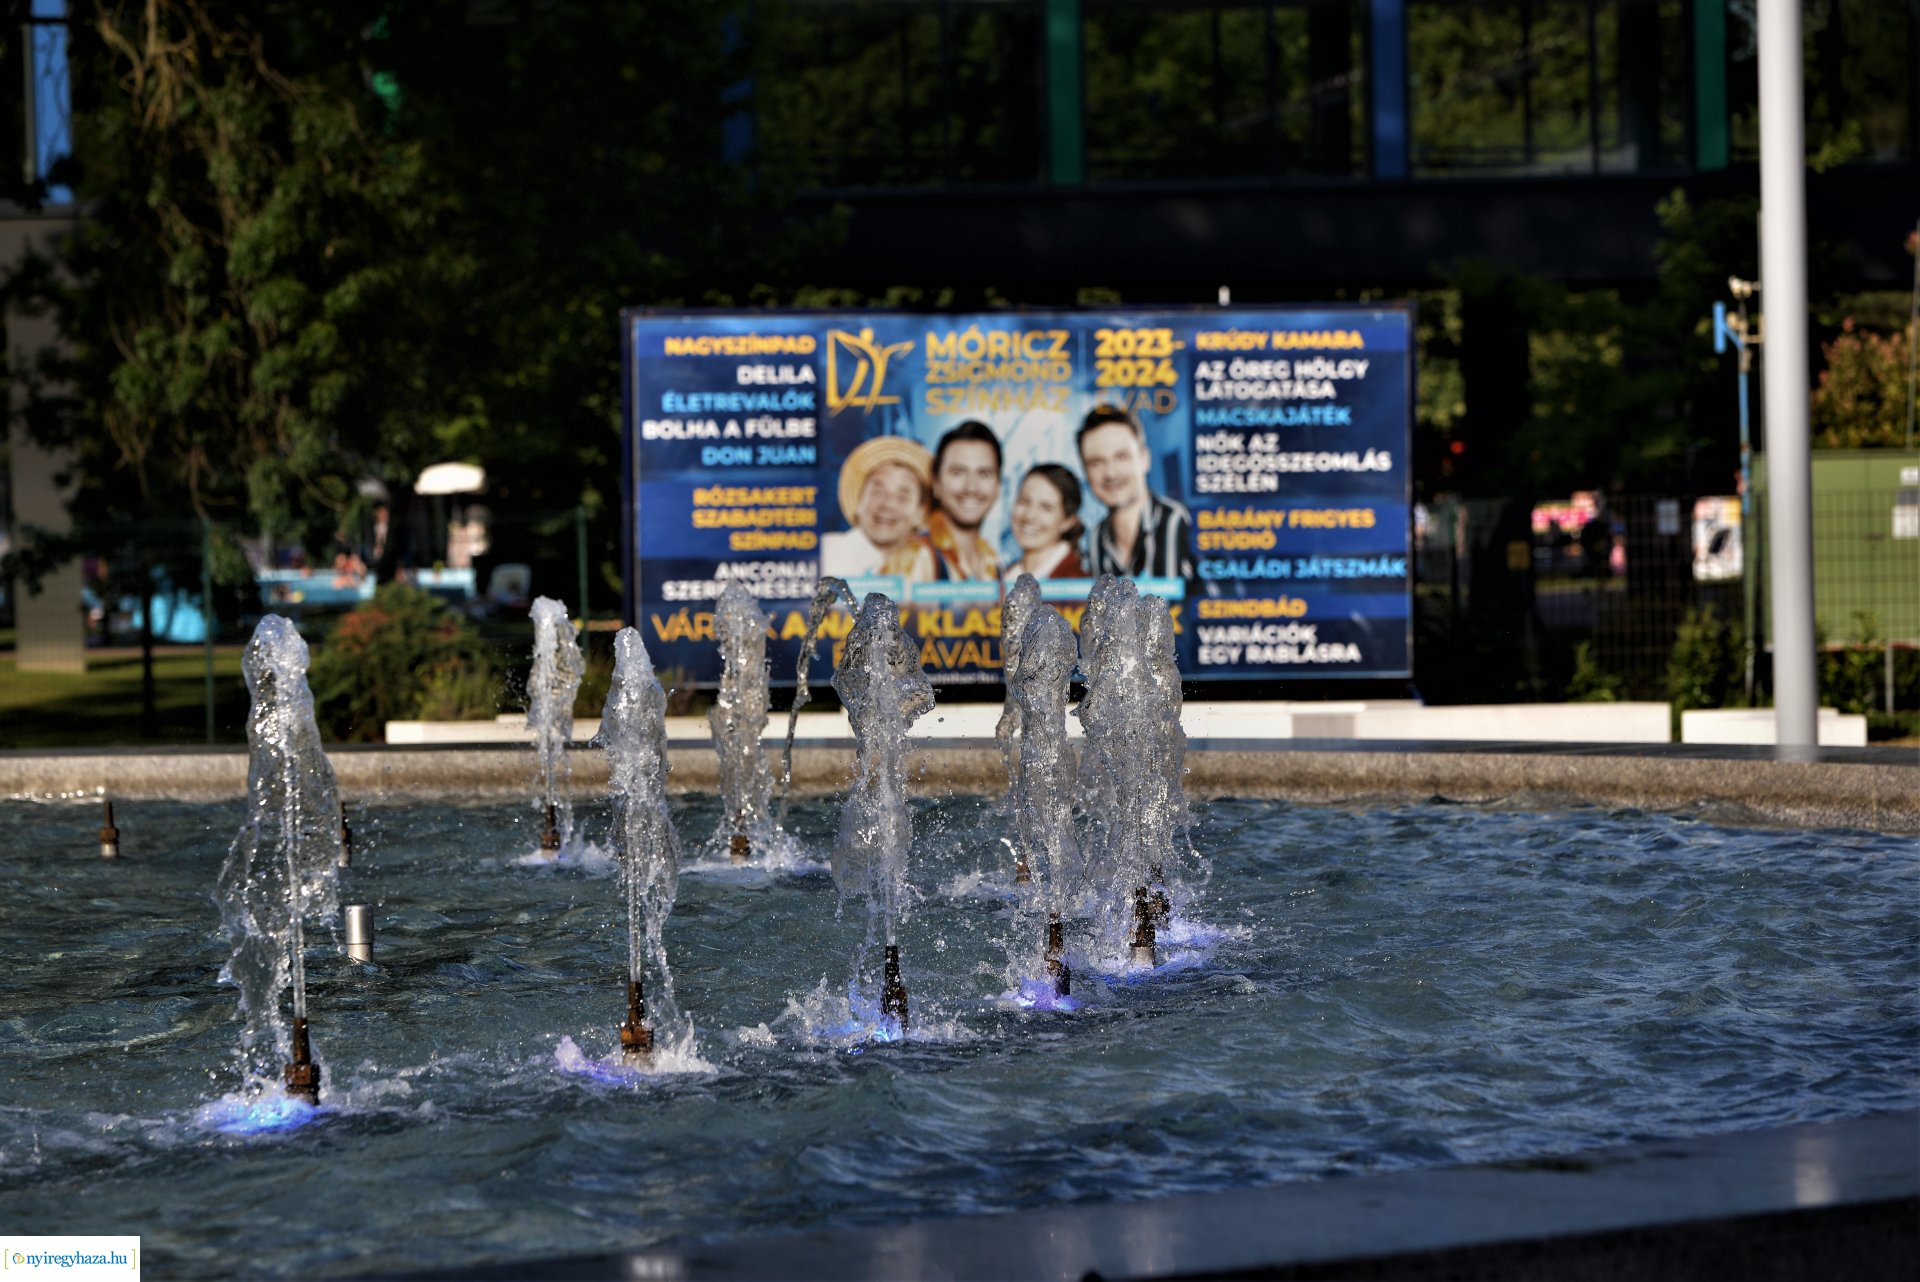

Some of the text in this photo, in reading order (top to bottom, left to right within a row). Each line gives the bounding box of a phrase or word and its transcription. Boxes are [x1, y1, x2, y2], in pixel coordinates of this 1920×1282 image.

[664, 333, 817, 356] NAGYSZÍNPAD
[925, 325, 1071, 361] MÓRICZ
[1196, 328, 1364, 350] KRÚDY KAMARA
[736, 364, 816, 385] DELILA
[925, 361, 1072, 383] ZSIGMOND
[1094, 359, 1178, 387] 2024
[1195, 356, 1369, 380] AZ ÖREG HÖLGY
[661, 388, 816, 412] ÉLETREVALÓK
[925, 382, 1071, 415] SZÍNHÁZ
[1195, 378, 1337, 400] LÁTOGATÁSA
[1195, 403, 1352, 426] MACSKAJÁTÉK
[642, 415, 817, 440] BOLHA A FÜLBE
[1248, 433, 1279, 453] AZ
[702, 444, 817, 466] DON JUAN
[1196, 449, 1392, 473] IDEGÖSSZEOMLÁS
[693, 484, 817, 506] RÓZSAKERT
[692, 506, 817, 528] SZABADTÉRI
[1197, 507, 1375, 529] BÁRÁNY FRIGYES
[729, 529, 817, 551] SZÍNPAD
[1197, 528, 1277, 550] STÚDIÓ
[714, 561, 817, 581] ANCONAI
[1197, 554, 1407, 579] CSALÁDI JÁTSZMÁK
[1198, 595, 1308, 619] SZINDBÁD
[1197, 621, 1317, 645] VARIÁCIÓK
[1198, 642, 1362, 664] EGY RABLÁSRA
